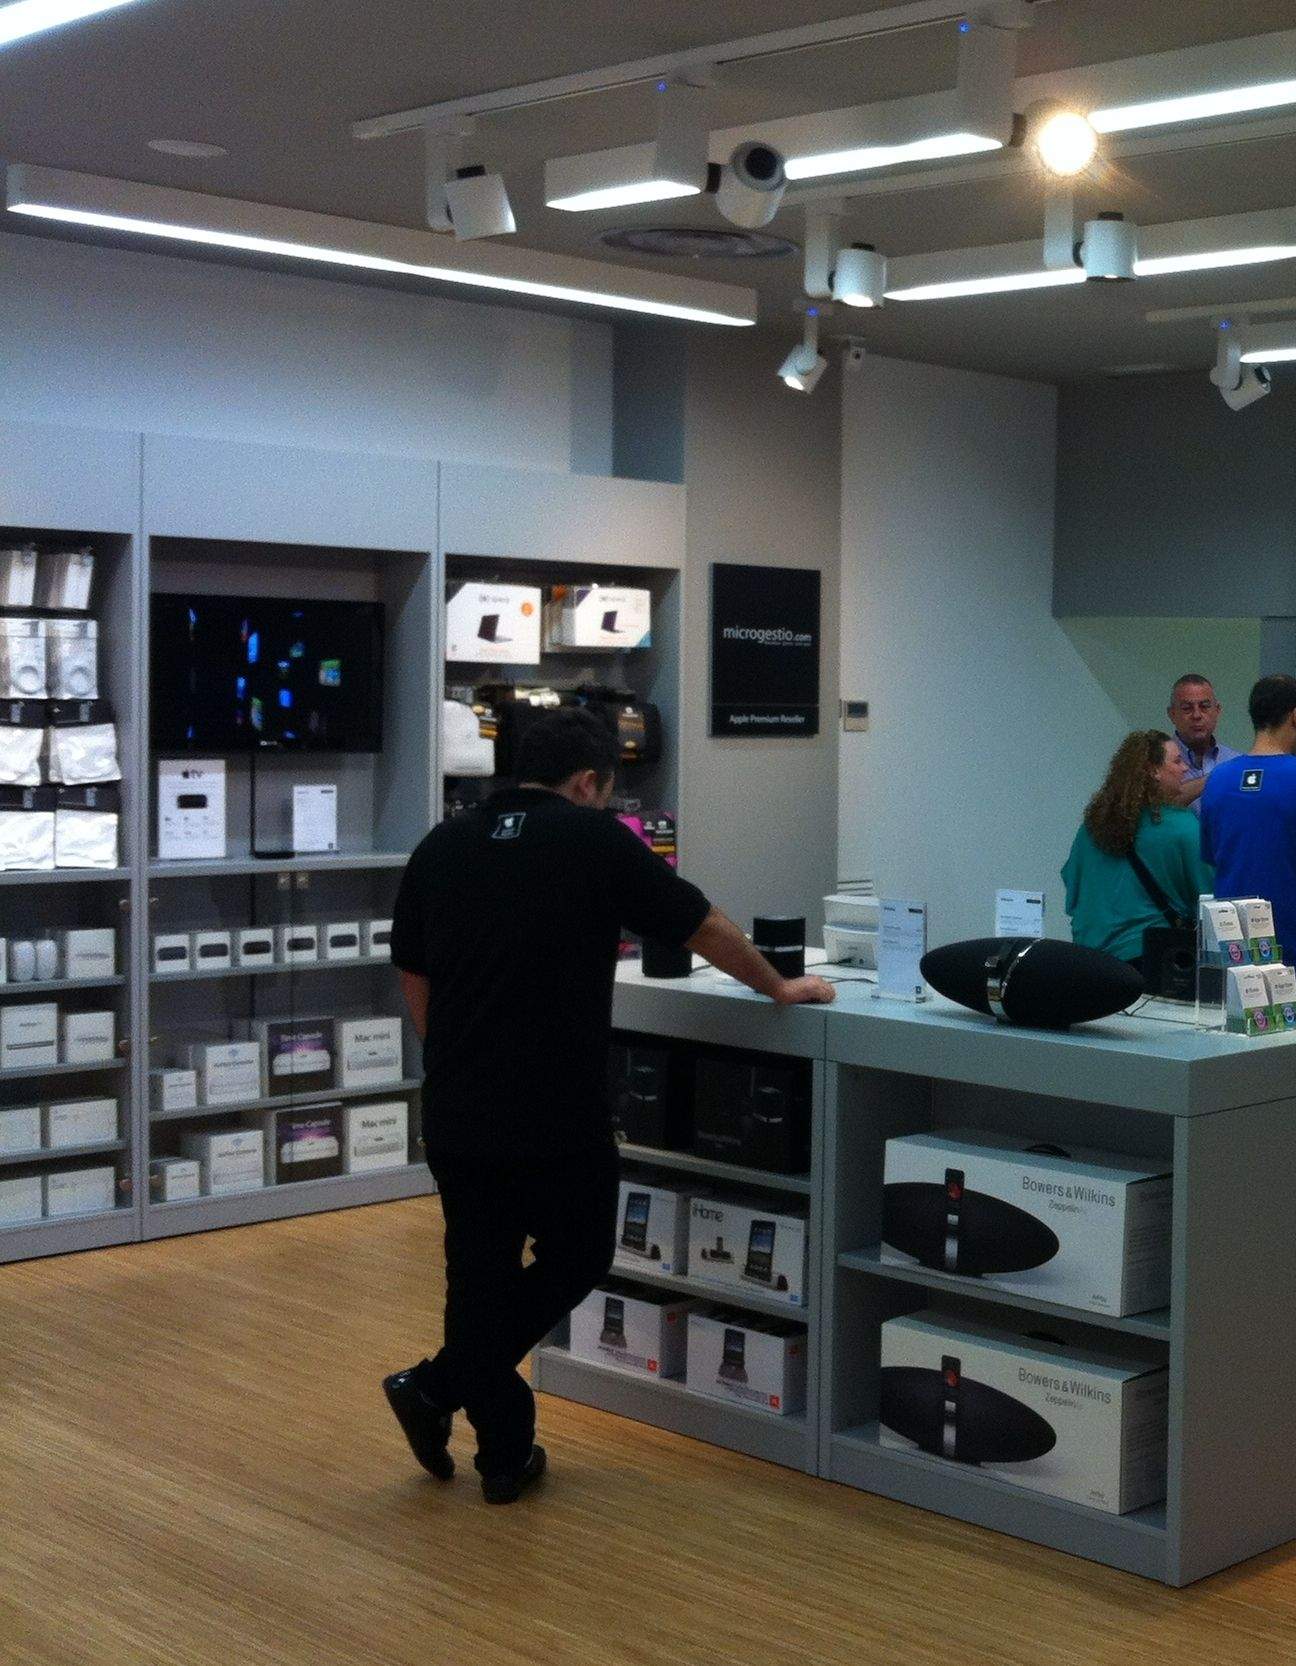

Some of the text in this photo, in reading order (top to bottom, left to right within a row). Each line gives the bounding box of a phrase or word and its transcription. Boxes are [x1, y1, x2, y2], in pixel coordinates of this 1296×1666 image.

[723, 624, 812, 643] microgestio.com
[729, 714, 805, 725] Apple Premium Reseller
[1022, 1175, 1116, 1207] Bowers & Wilkins
[1018, 1367, 1112, 1404] Bowers & Wilkins
